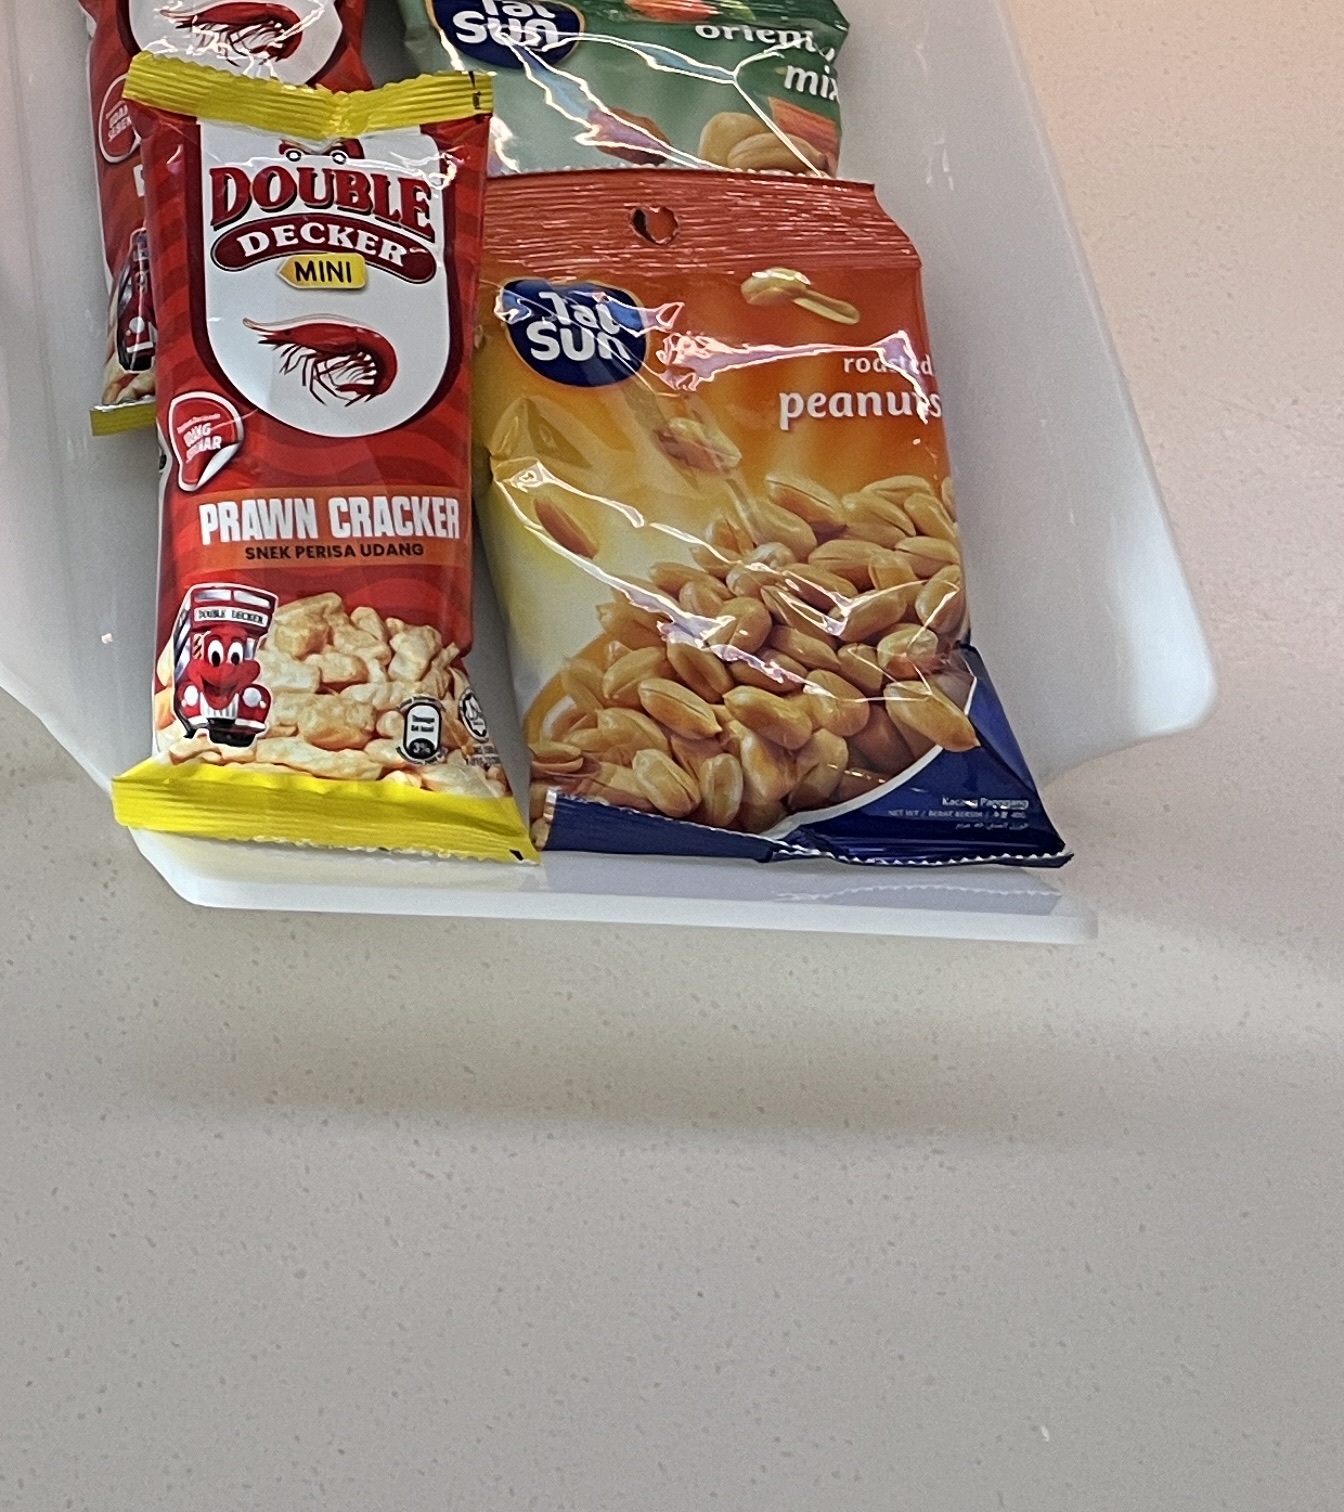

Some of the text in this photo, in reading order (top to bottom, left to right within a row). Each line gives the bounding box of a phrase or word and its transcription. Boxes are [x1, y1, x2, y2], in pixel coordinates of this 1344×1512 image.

[210, 165, 436, 244] DOUBLE
[236, 221, 408, 268] DECKER
[294, 261, 352, 284] MINI
[526, 320, 632, 362] Sun
[198, 495, 460, 546] PRAWN CRACKER
[245, 542, 425, 560] SNEK PERISA UDANG
